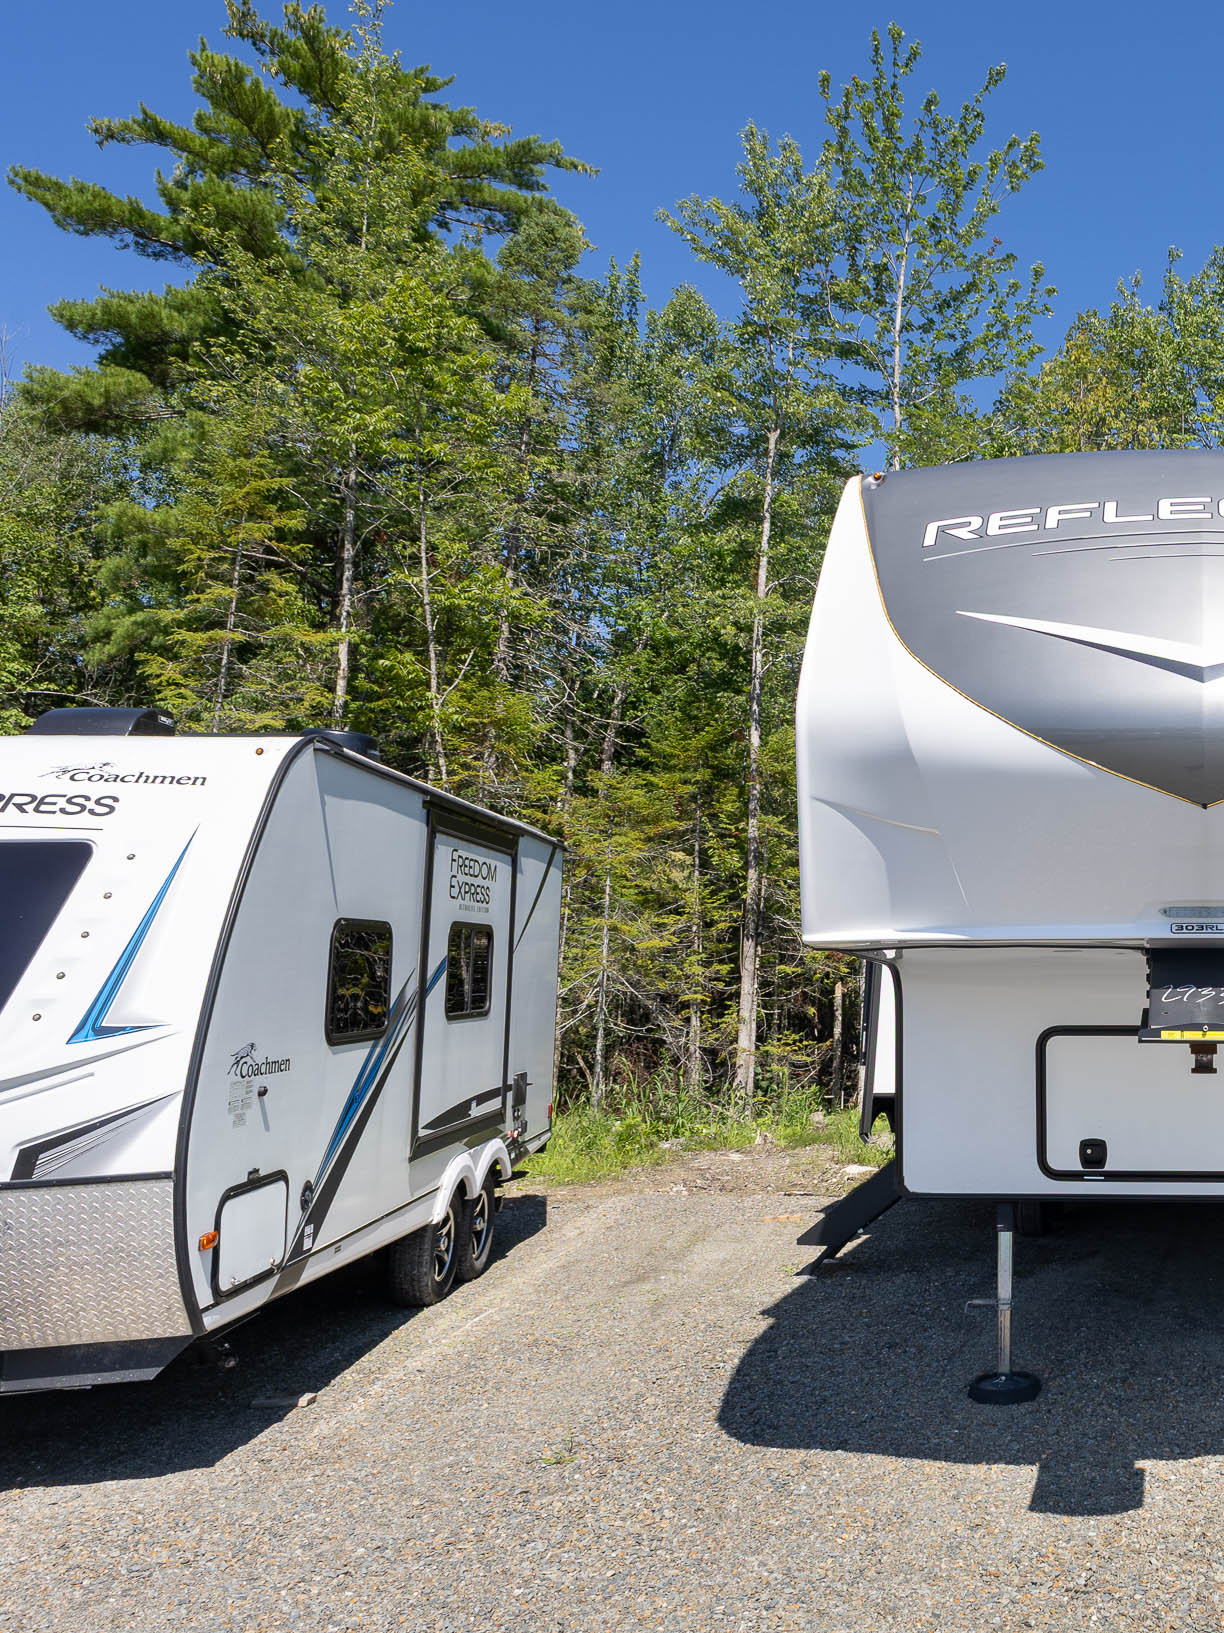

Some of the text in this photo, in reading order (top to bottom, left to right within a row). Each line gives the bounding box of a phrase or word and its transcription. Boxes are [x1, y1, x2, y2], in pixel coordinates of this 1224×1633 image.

[68, 770, 208, 786] Coachmen
[0, 793, 120, 816] RESS
[450, 848, 498, 883] FREEDOM
[449, 874, 491, 905] EXPRESS
[240, 1057, 291, 1079] Coachmen
